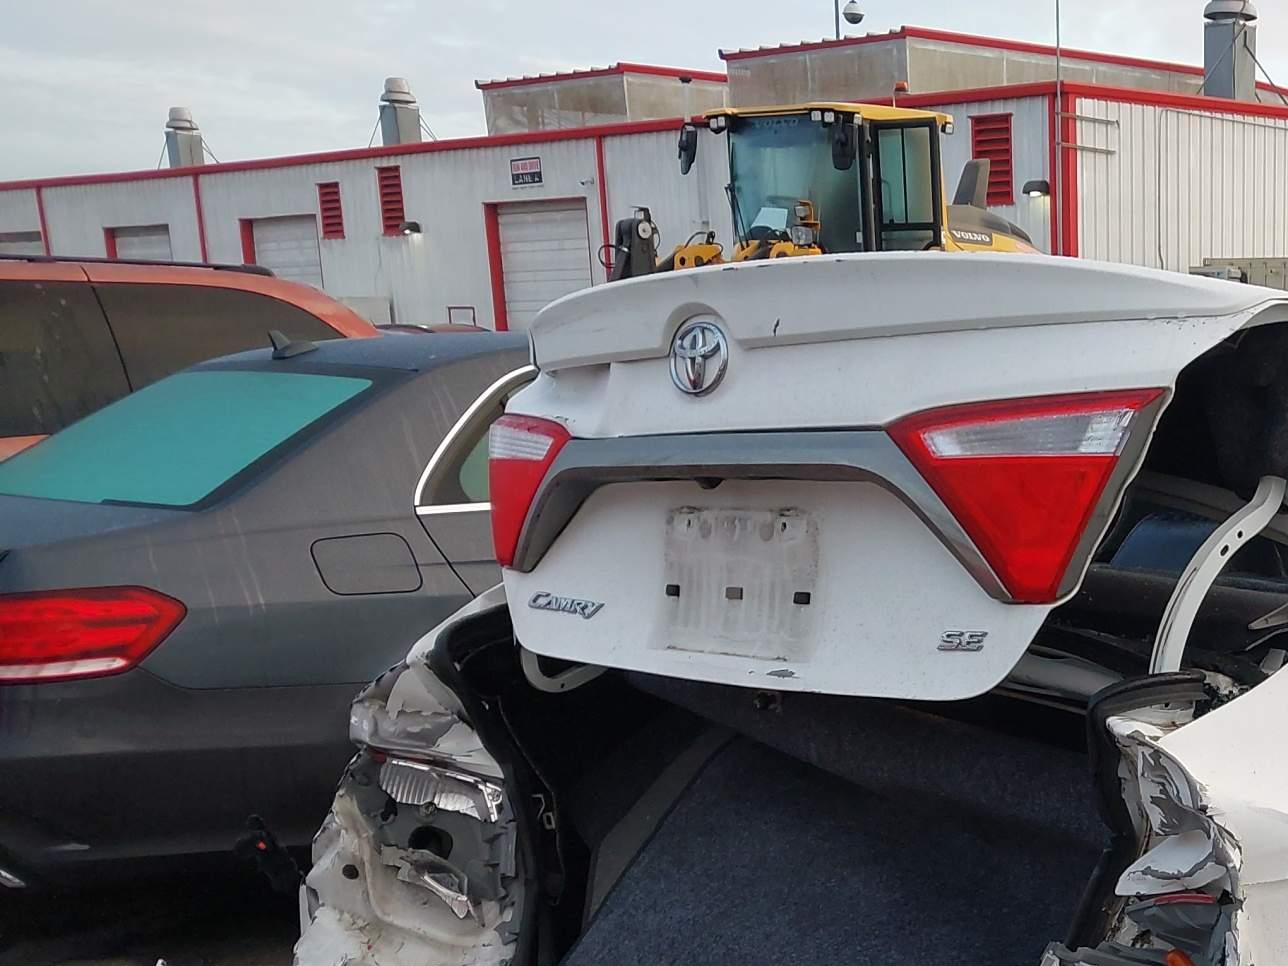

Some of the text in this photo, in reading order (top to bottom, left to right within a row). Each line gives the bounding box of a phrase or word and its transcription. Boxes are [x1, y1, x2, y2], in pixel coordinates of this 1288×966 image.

[514, 174, 533, 184] LANE
[951, 230, 991, 242] VOLVO
[936, 630, 988, 652] SE
